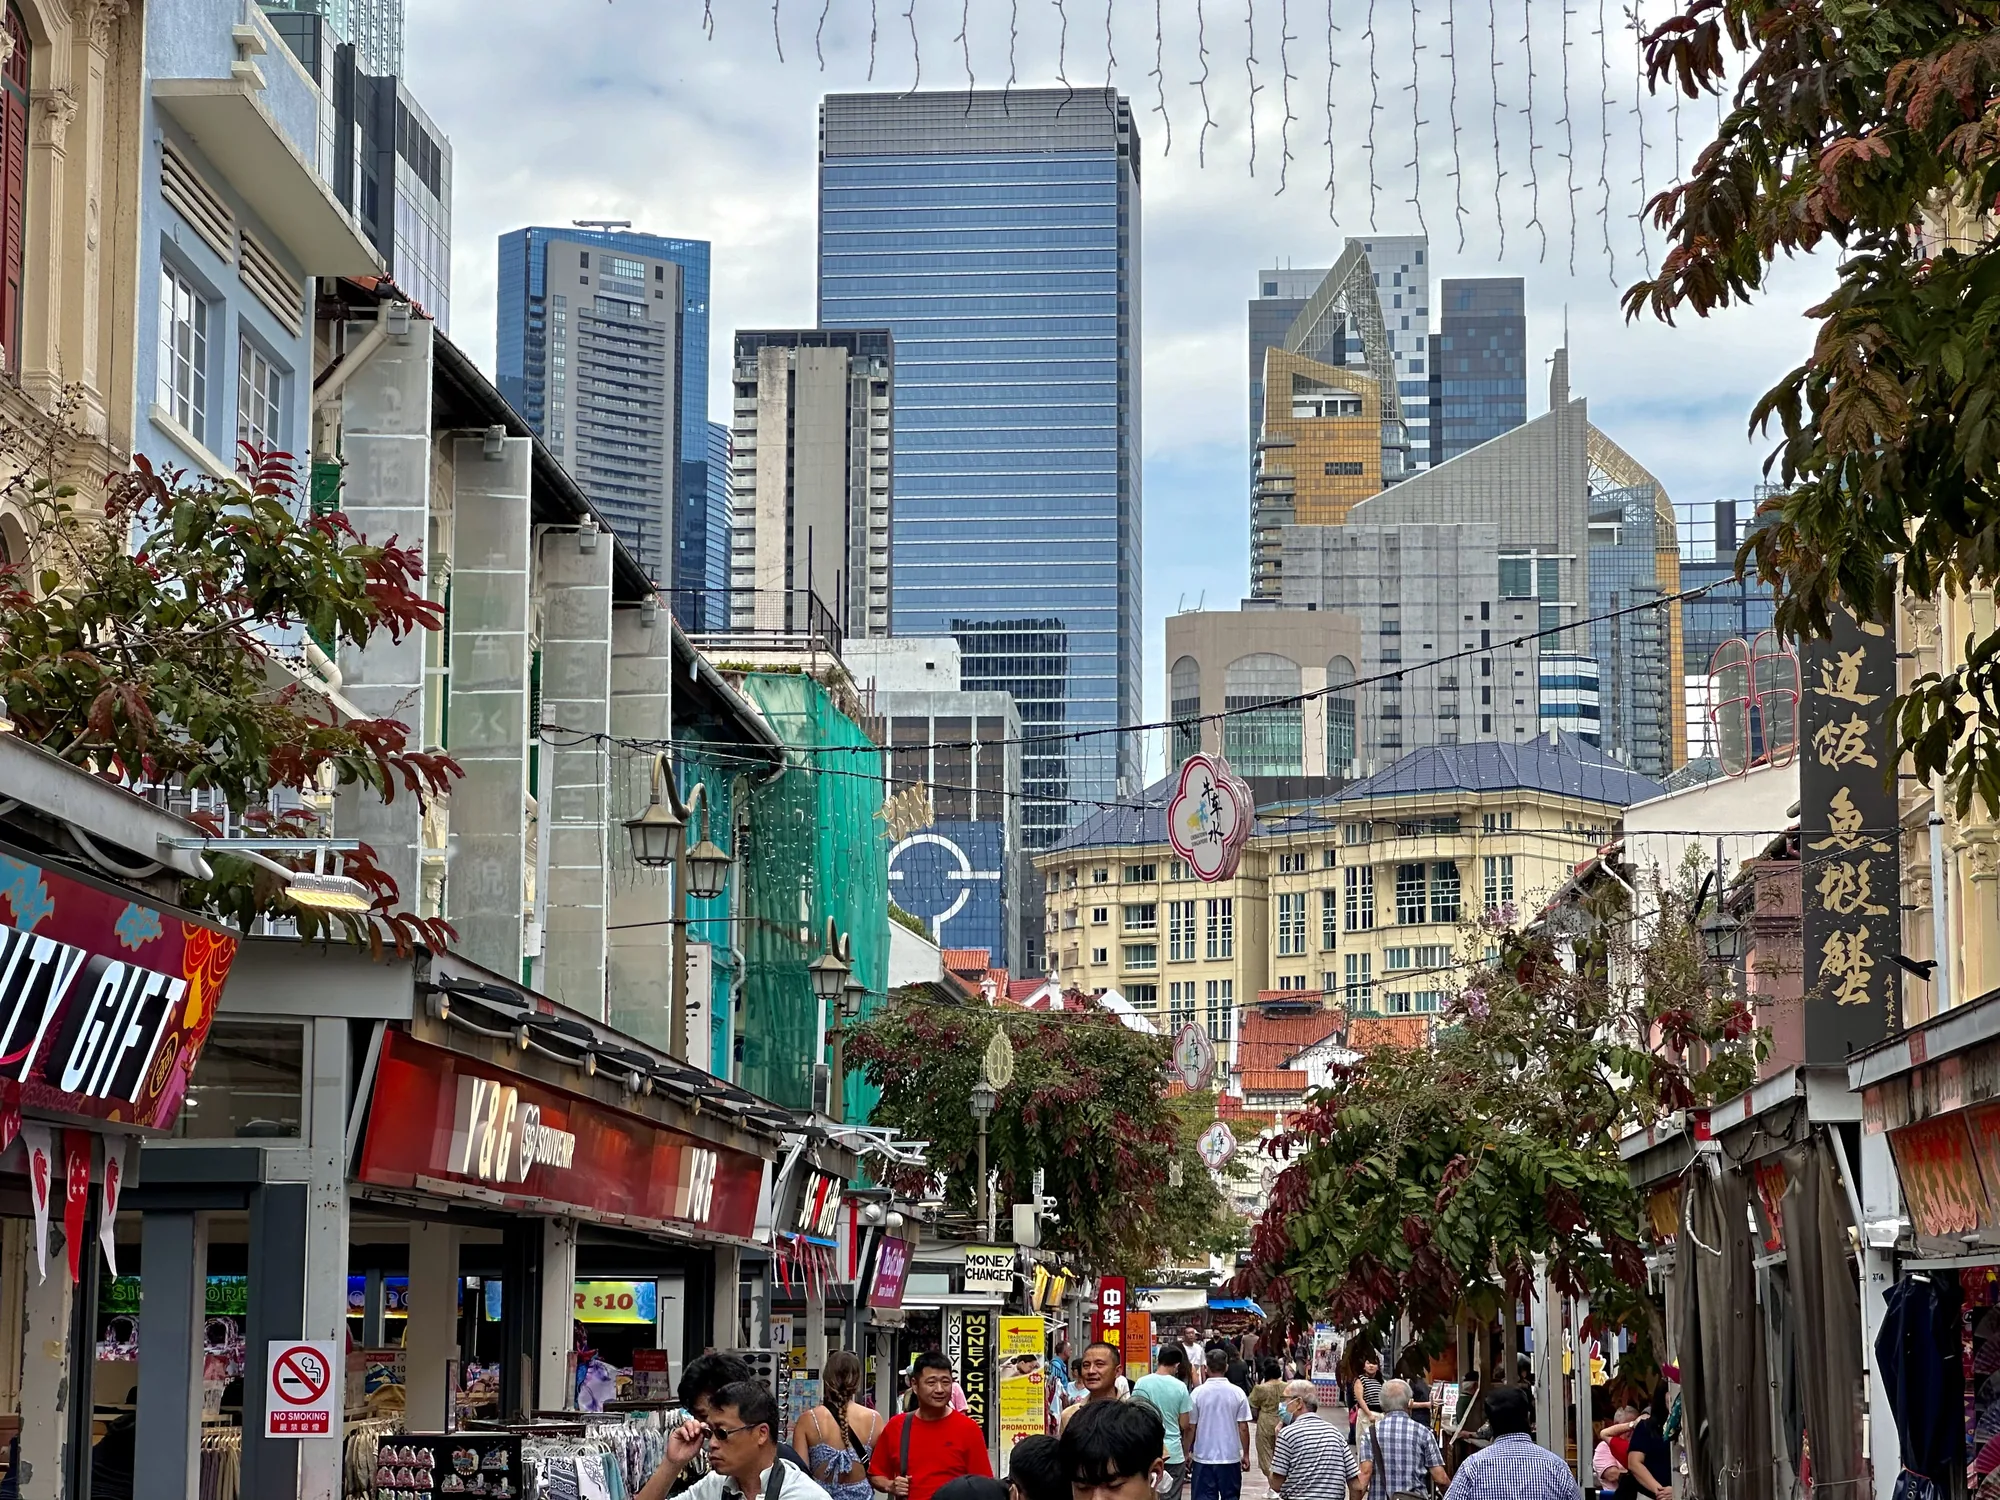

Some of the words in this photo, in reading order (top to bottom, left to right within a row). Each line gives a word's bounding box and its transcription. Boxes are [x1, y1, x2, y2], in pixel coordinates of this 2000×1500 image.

[61, 961, 187, 1104] GIFT
[463, 1078, 518, 1183] Y&G
[536, 1125, 576, 1170] SOUVENIR
[686, 1148, 717, 1223] Y&G
[965, 1254, 1014, 1268] MONEY
[965, 1268, 1014, 1281] CHANGER
[593, 1293, 634, 1310] $10
[949, 1315, 960, 1366] MONEY
[966, 1315, 986, 1367] MONEY
[273, 1412, 286, 1421] NO
[288, 1412, 327, 1421] SMOKING
